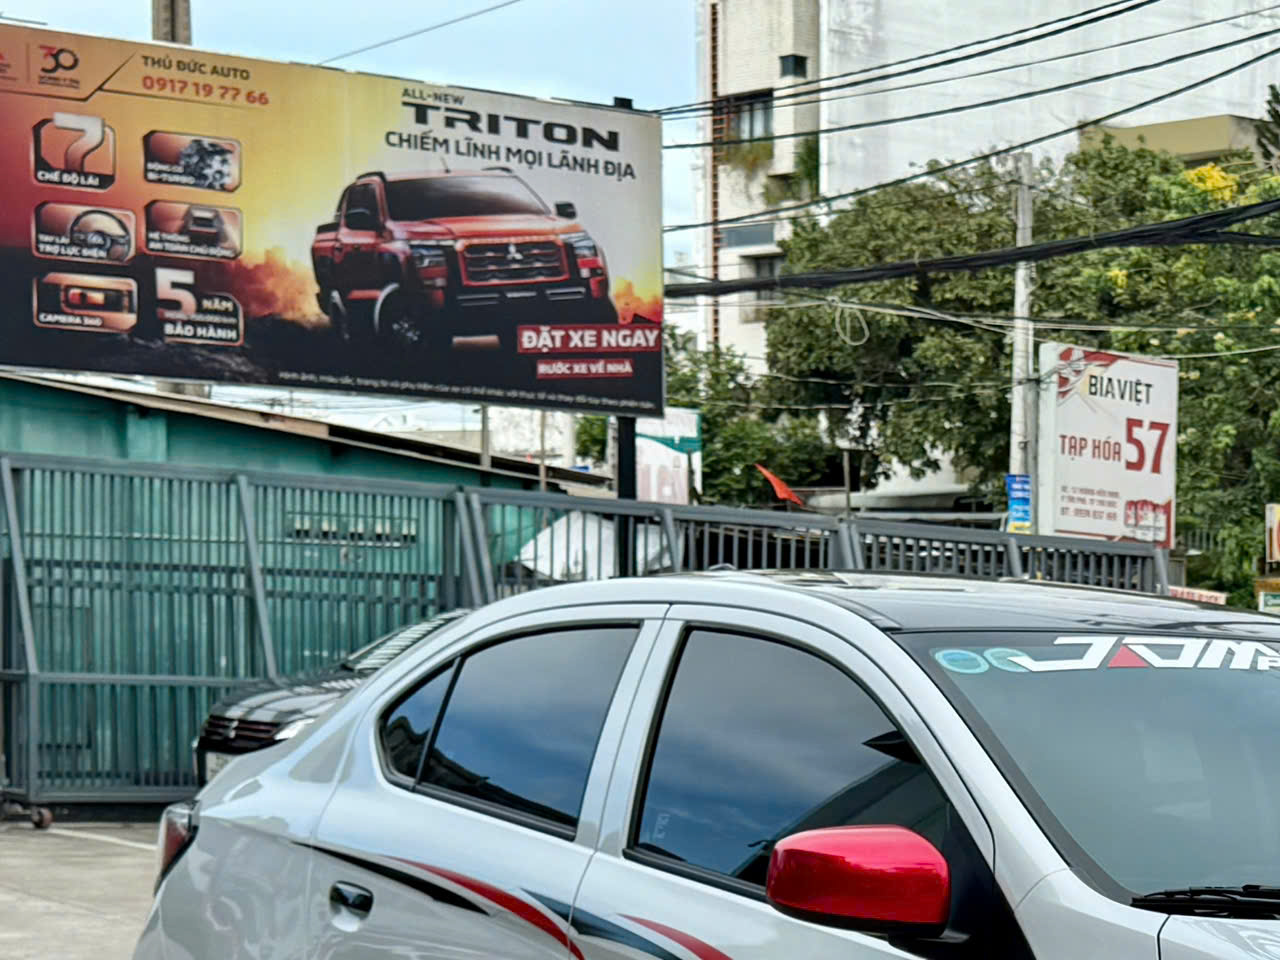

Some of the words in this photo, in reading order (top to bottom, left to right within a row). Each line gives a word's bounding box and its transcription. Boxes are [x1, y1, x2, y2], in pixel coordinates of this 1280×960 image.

[141, 54, 172, 70] THỦ
[176, 58, 206, 75] ĐỨC
[210, 65, 250, 80] AUTO
[142, 76, 190, 95] 0917
[193, 82, 213, 97] 19
[246, 90, 269, 105] 66
[402, 88, 464, 106] ALL-NEW
[53, 112, 105, 174] 7
[401, 101, 619, 151] TRITON
[385, 129, 450, 154] CHIẾM
[454, 136, 500, 162] LĨNH
[506, 148, 543, 170] MỌI
[547, 150, 601, 174] LÃNH
[604, 160, 637, 182] ĐỊA
[156, 267, 197, 315] 5
[521, 326, 566, 353] ĐẶT
[568, 330, 597, 348] XE
[602, 329, 659, 348] NGAY
[1059, 434, 1088, 461] TẠP
[1092, 435, 1121, 462] HÓA
[1125, 417, 1171, 474] 57
